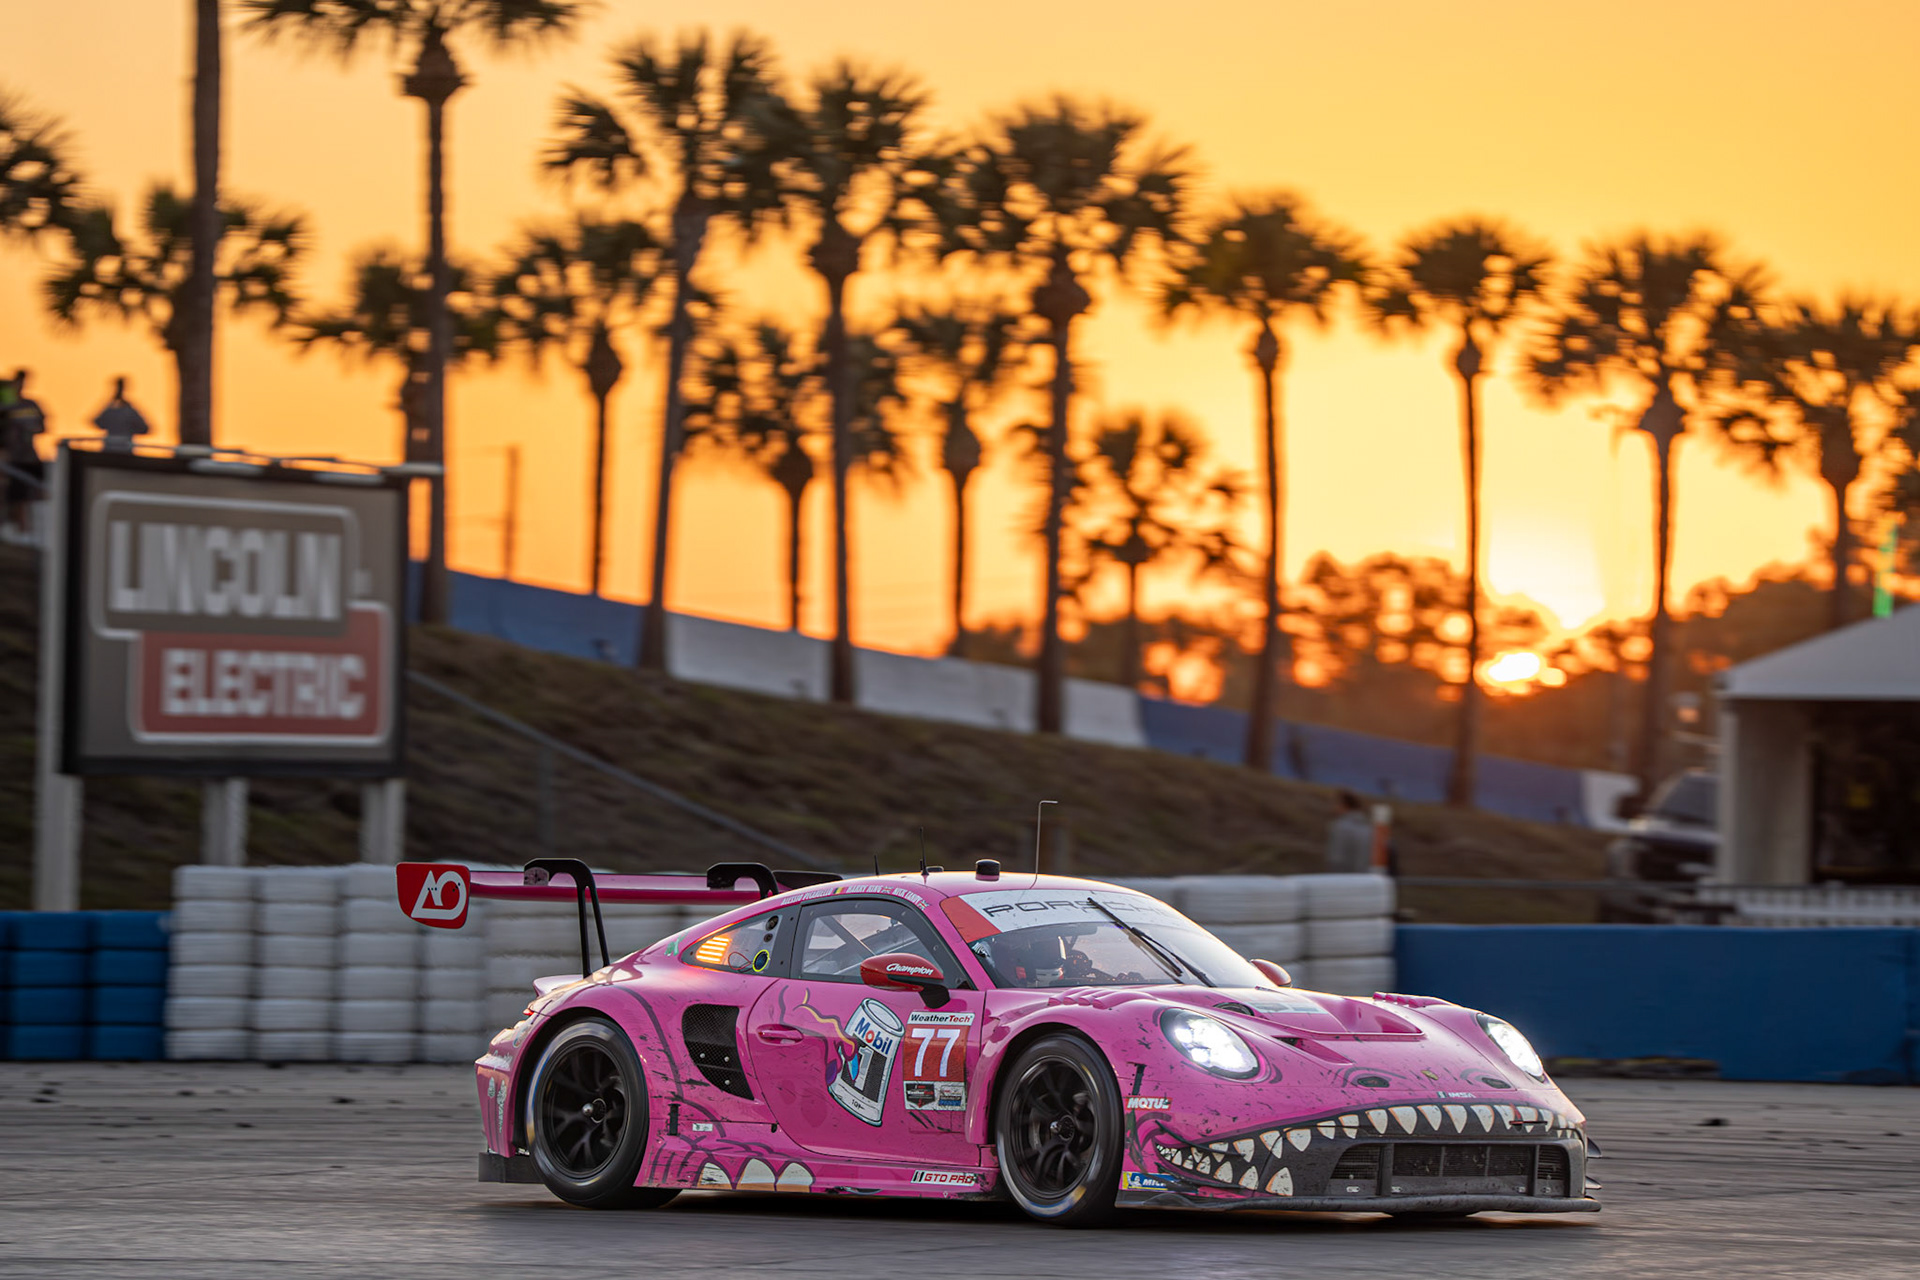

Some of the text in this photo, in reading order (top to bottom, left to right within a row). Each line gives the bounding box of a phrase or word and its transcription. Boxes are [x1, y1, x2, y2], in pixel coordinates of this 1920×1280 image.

[108, 520, 341, 621] LINCOLN
[161, 648, 366, 720] ELECTRIC
[886, 963, 934, 975] Champion
[910, 1014, 971, 1023] WeatherTech
[854, 1017, 893, 1055] Mobil
[911, 1028, 961, 1077] 77
[1127, 1097, 1170, 1109] MOTUL
[924, 1173, 974, 1184] GTD PRO
